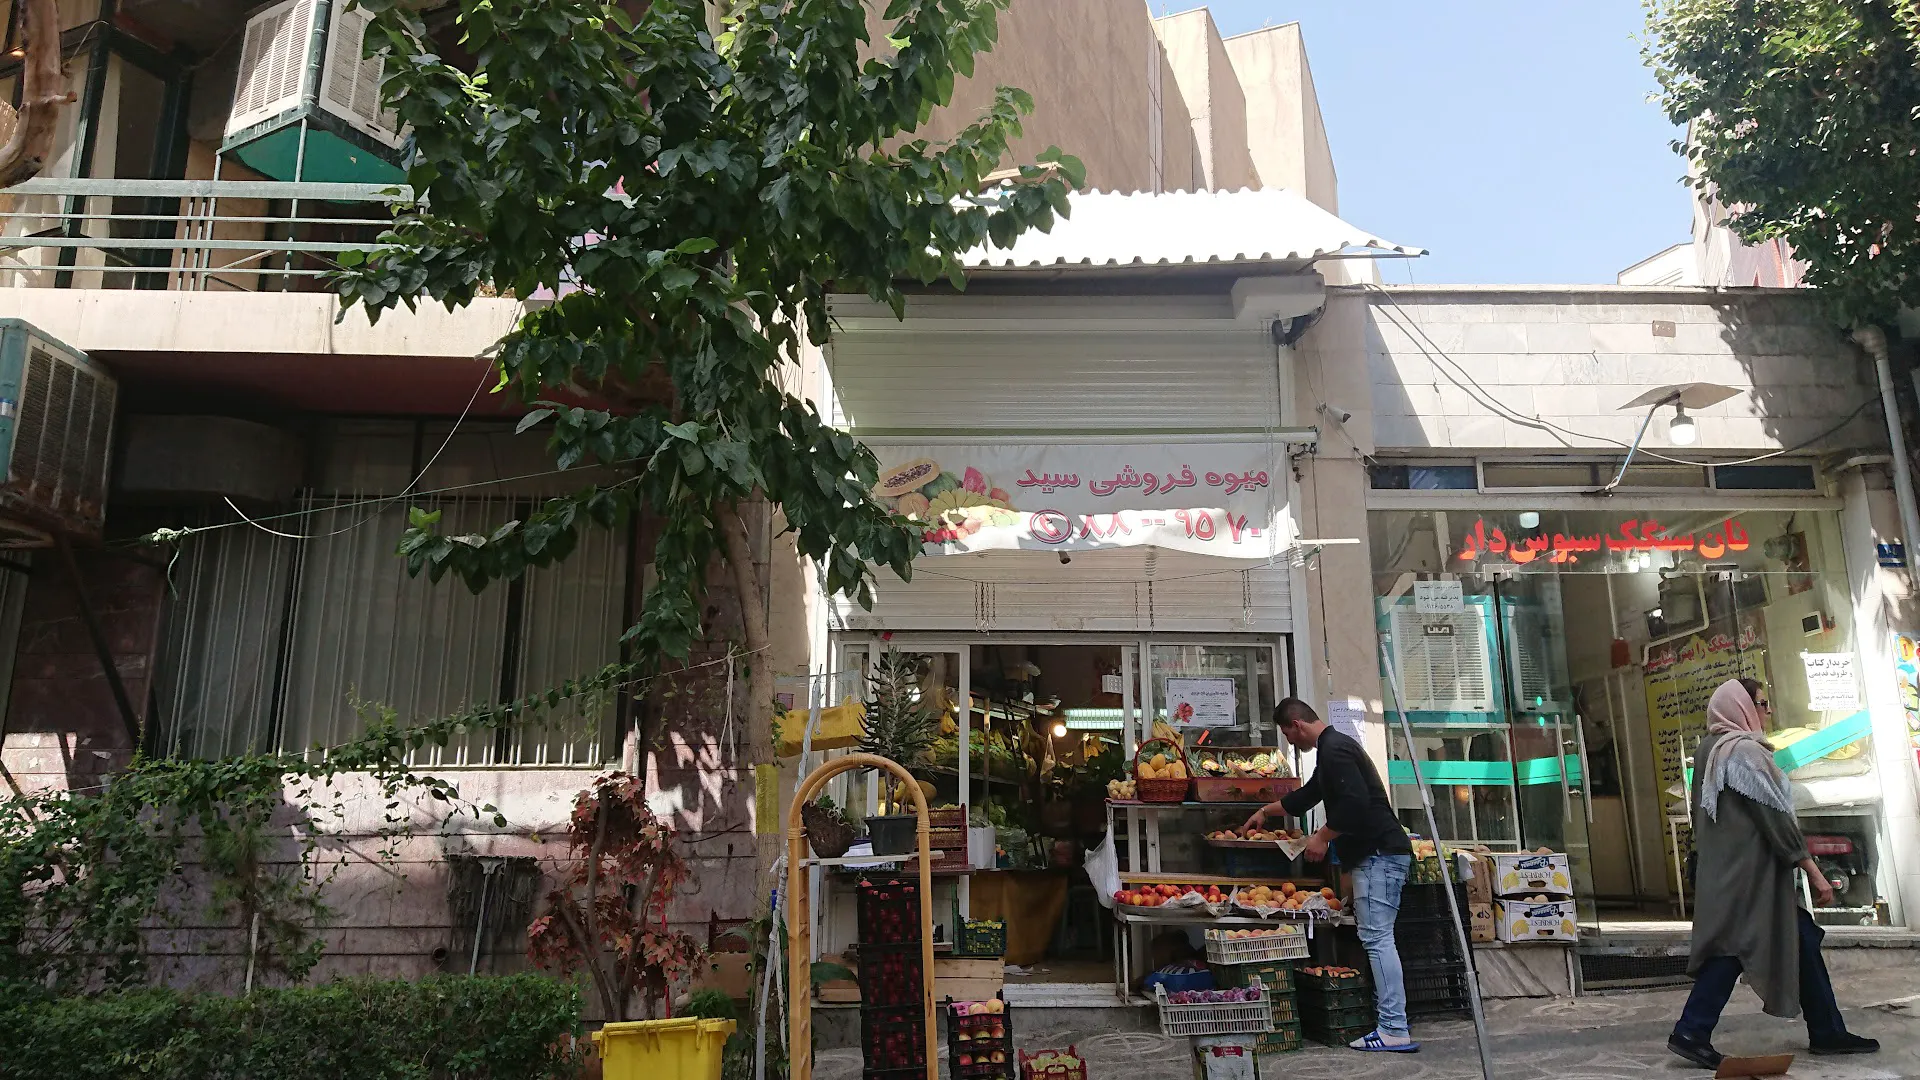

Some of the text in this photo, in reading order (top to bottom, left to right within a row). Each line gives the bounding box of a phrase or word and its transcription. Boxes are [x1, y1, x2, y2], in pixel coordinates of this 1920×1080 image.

[1016, 463, 1269, 496] میوه فروشی سید
[1459, 517, 1507, 561] دار
[1605, 519, 1694, 551] سنگک
[1700, 518, 1749, 559] نان
[1806, 658, 1825, 669] کتاب
